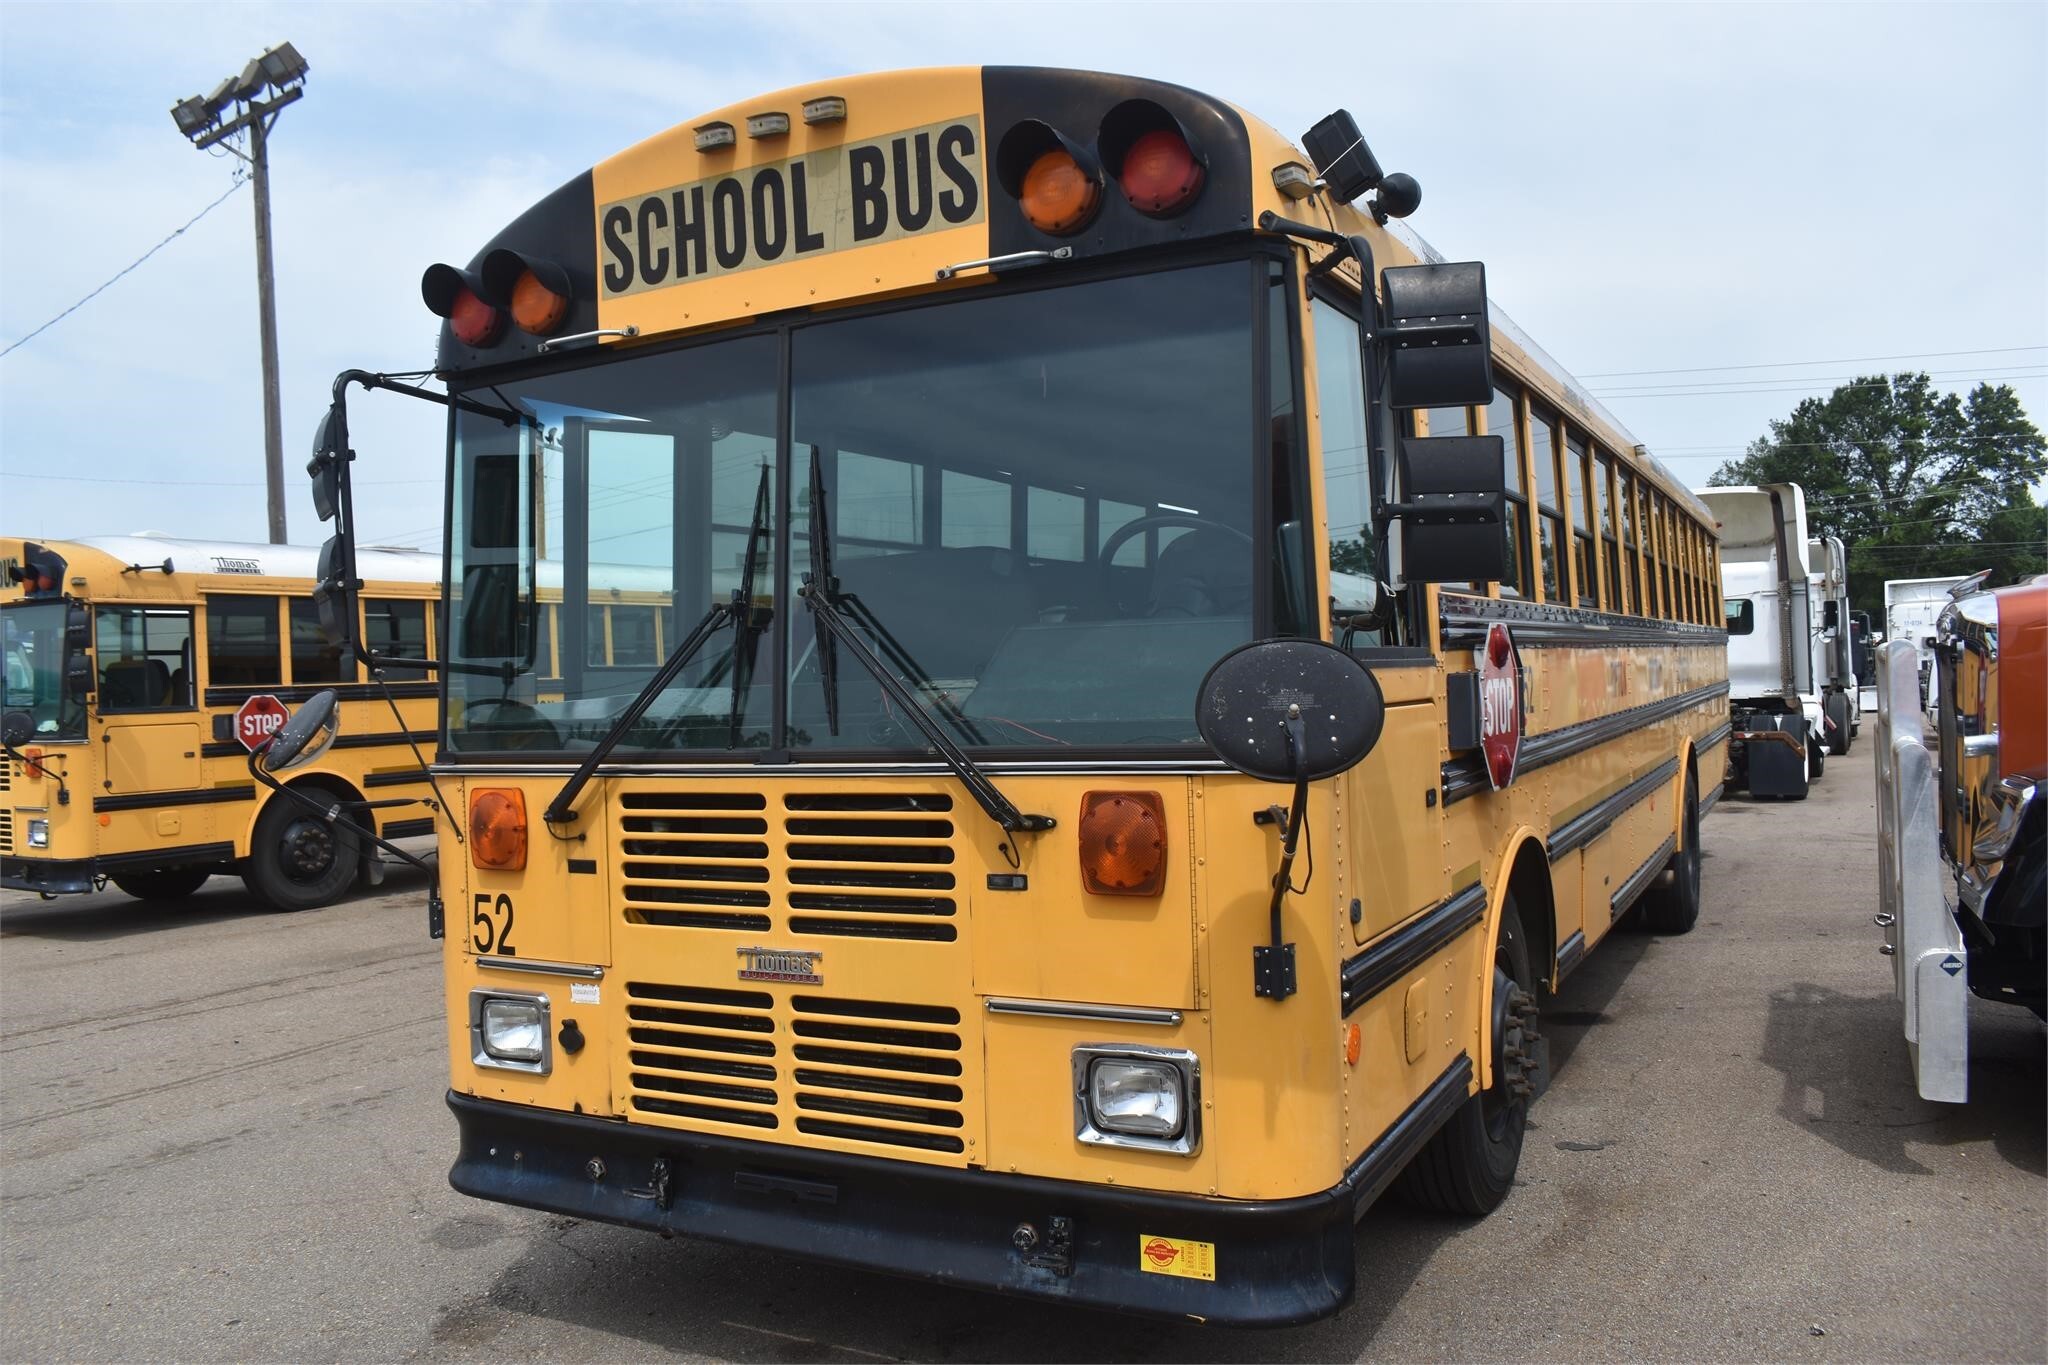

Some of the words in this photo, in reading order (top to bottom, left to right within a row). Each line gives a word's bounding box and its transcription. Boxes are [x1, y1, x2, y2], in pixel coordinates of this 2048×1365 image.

[603, 160, 825, 294] SCHOOL
[849, 124, 979, 243] BUS
[210, 556, 260, 569] Thomas
[243, 713, 283, 736] STOP
[1485, 677, 1514, 737] STOP
[474, 893, 516, 956] 52
[737, 946, 822, 974] Thomas
